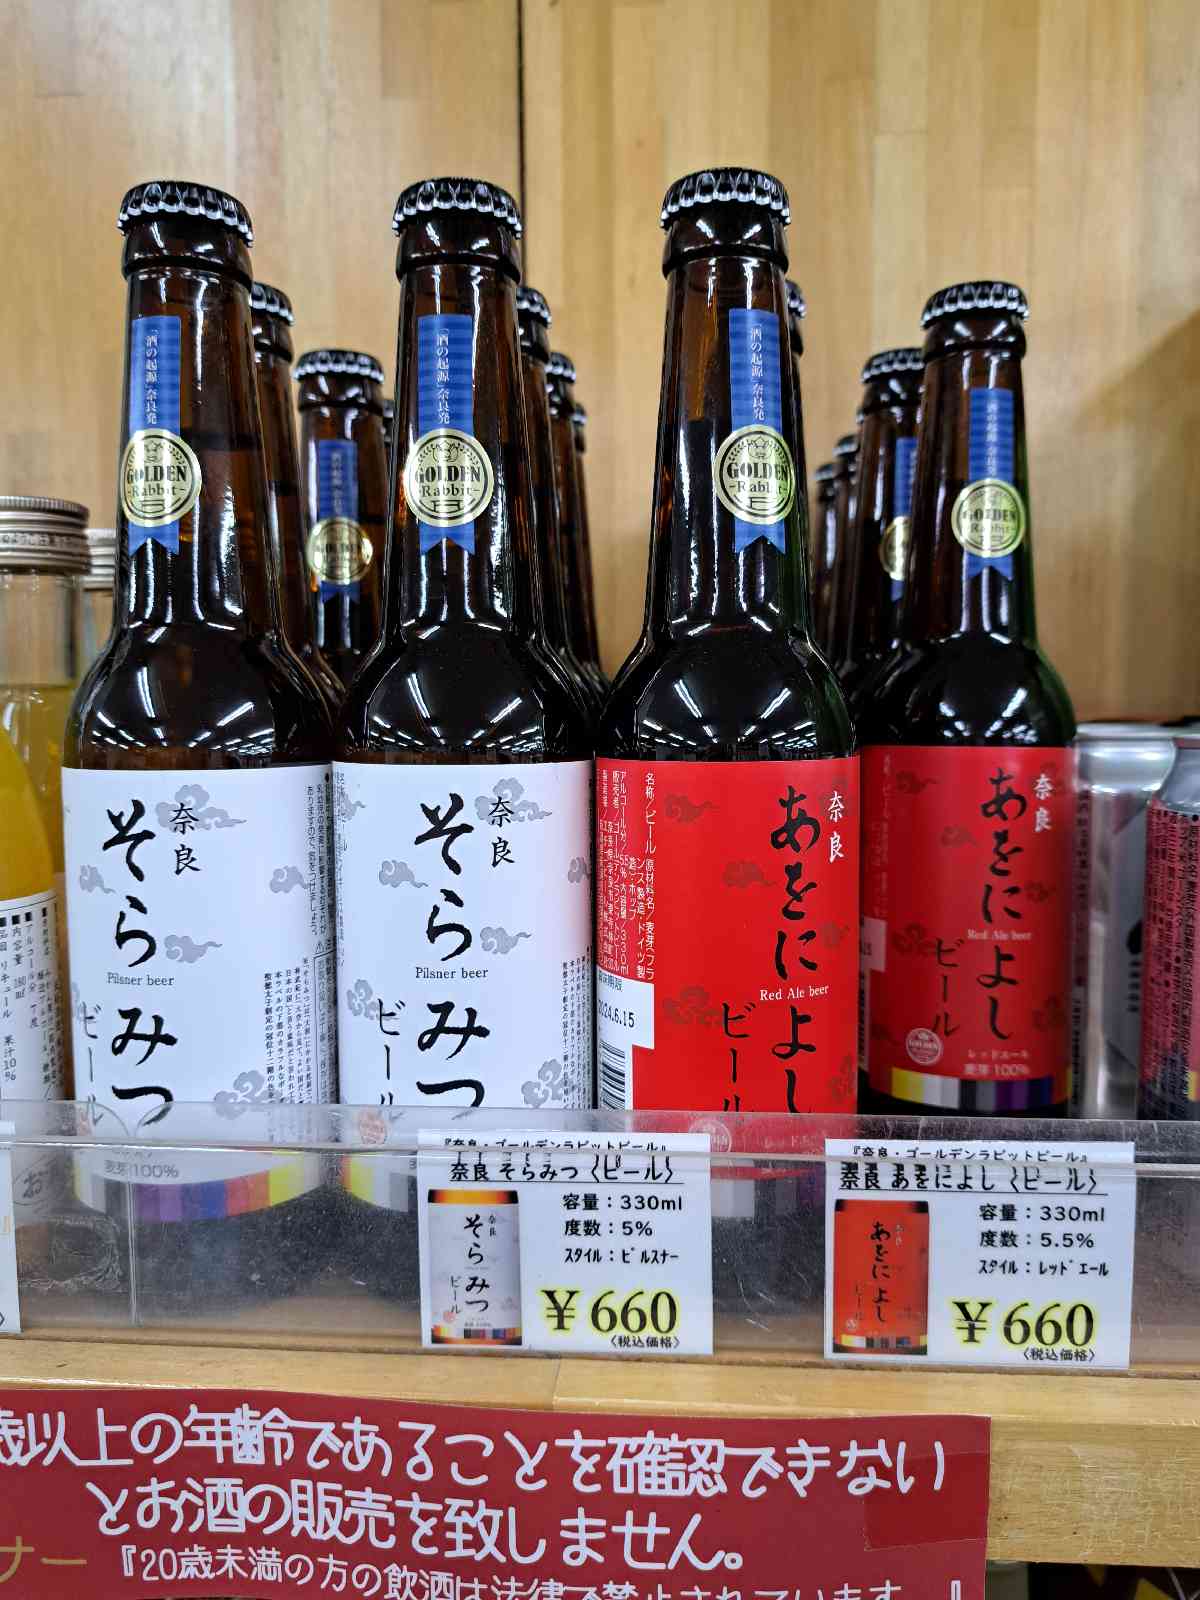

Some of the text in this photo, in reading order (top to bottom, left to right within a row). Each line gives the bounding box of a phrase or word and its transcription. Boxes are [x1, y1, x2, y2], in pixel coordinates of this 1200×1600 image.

[126, 465, 188, 484] GOLDEN
[415, 465, 481, 484] GOLDEN
[726, 462, 788, 480] GOLDEN
[169, 802, 200, 875] 奈良
[488, 796, 515, 868] 奈良
[828, 790, 845, 863] 奈良
[1033, 773, 1053, 832] 奈良
[979, 767, 1028, 1040] あをによし
[102, 799, 178, 1126] そらみつ
[107, 972, 174, 986] Pilsner beer
[414, 792, 490, 1120] そらみつ
[415, 966, 489, 979] Pilsner beer
[770, 785, 821, 1114] あをによし
[760, 983, 829, 1001] Red Ale beer
[932, 937, 965, 1037] ビール
[450, 1161, 489, 1182] 奈良
[499, 1161, 579, 1182] そらみつ
[840, 1161, 881, 1190] 奈良
[891, 1163, 995, 1192] あをによし
[463, 1213, 490, 1313] そらみつ
[869, 1221, 891, 1323] あをによし
[86, 1477, 744, 1571] とお酒の販売を致しません。
